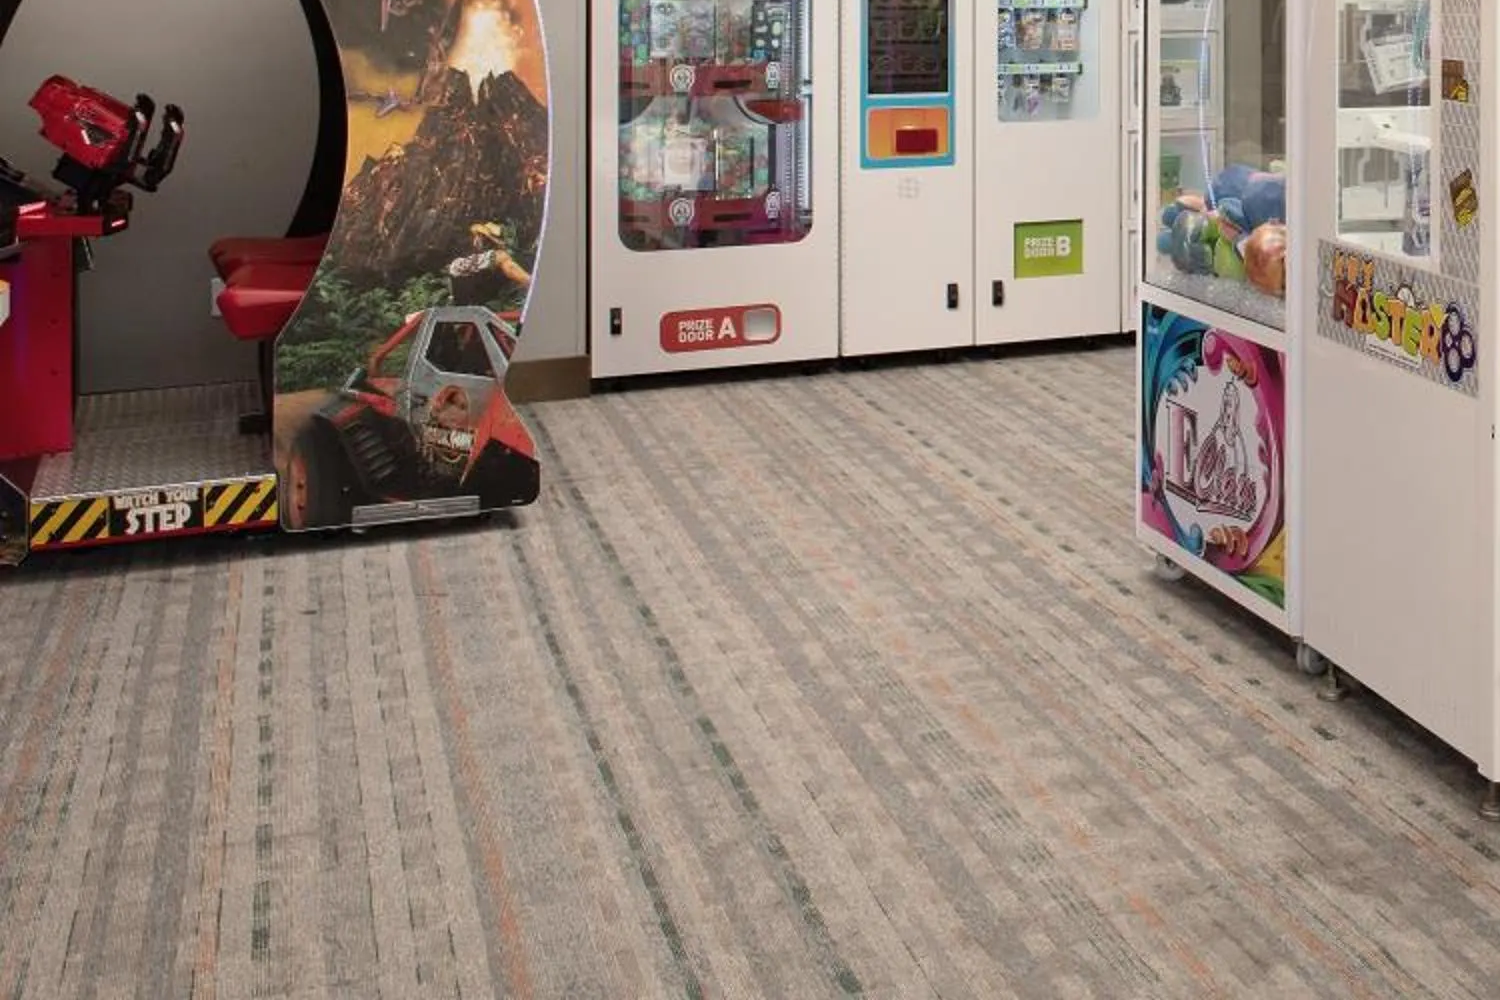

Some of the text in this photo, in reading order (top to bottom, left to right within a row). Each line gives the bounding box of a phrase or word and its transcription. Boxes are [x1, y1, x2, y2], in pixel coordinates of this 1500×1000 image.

[1056, 235, 1071, 257] B
[678, 318, 714, 332] PRIZE
[717, 316, 737, 340] A
[1333, 280, 1441, 366] MASTER
[678, 330, 714, 343] DOOR
[125, 502, 191, 535] STEP
